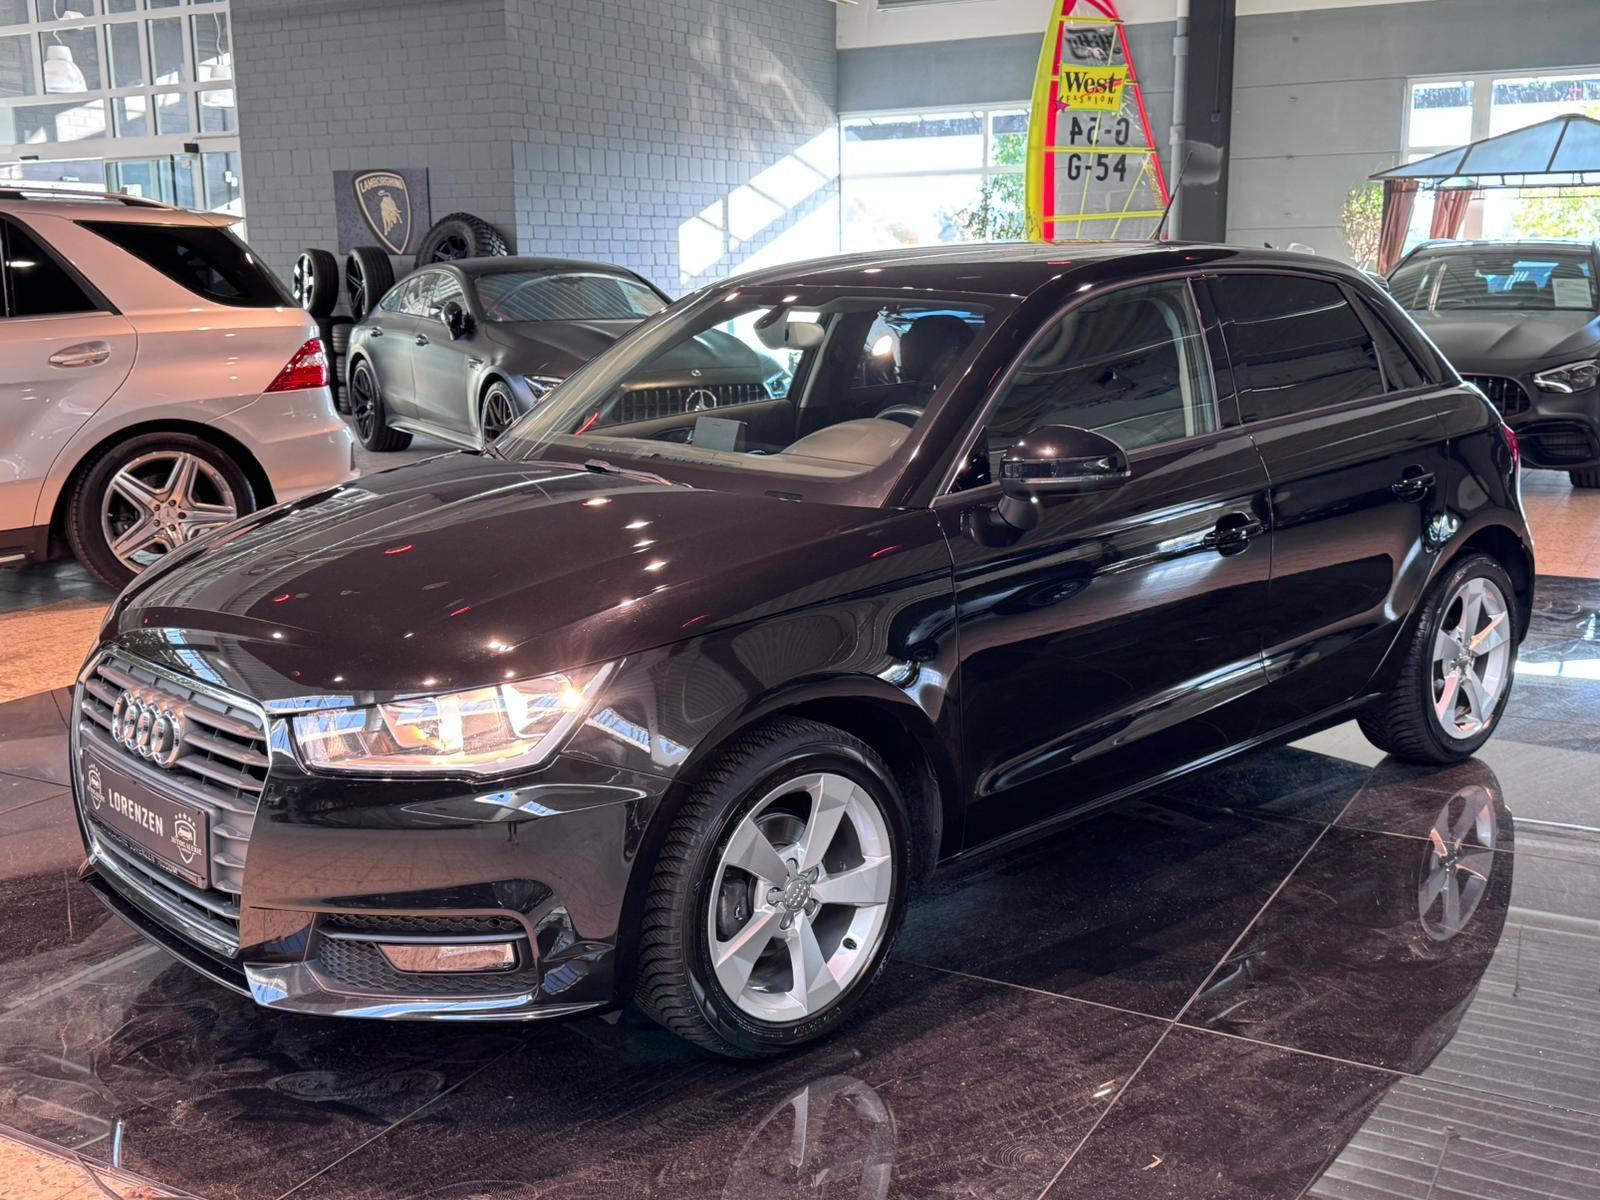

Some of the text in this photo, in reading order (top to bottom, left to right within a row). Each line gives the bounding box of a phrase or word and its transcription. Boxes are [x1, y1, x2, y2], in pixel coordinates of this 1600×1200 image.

[1064, 71, 1121, 94] West
[1067, 153, 1127, 182] G-54
[108, 788, 164, 837] LORENZEN
